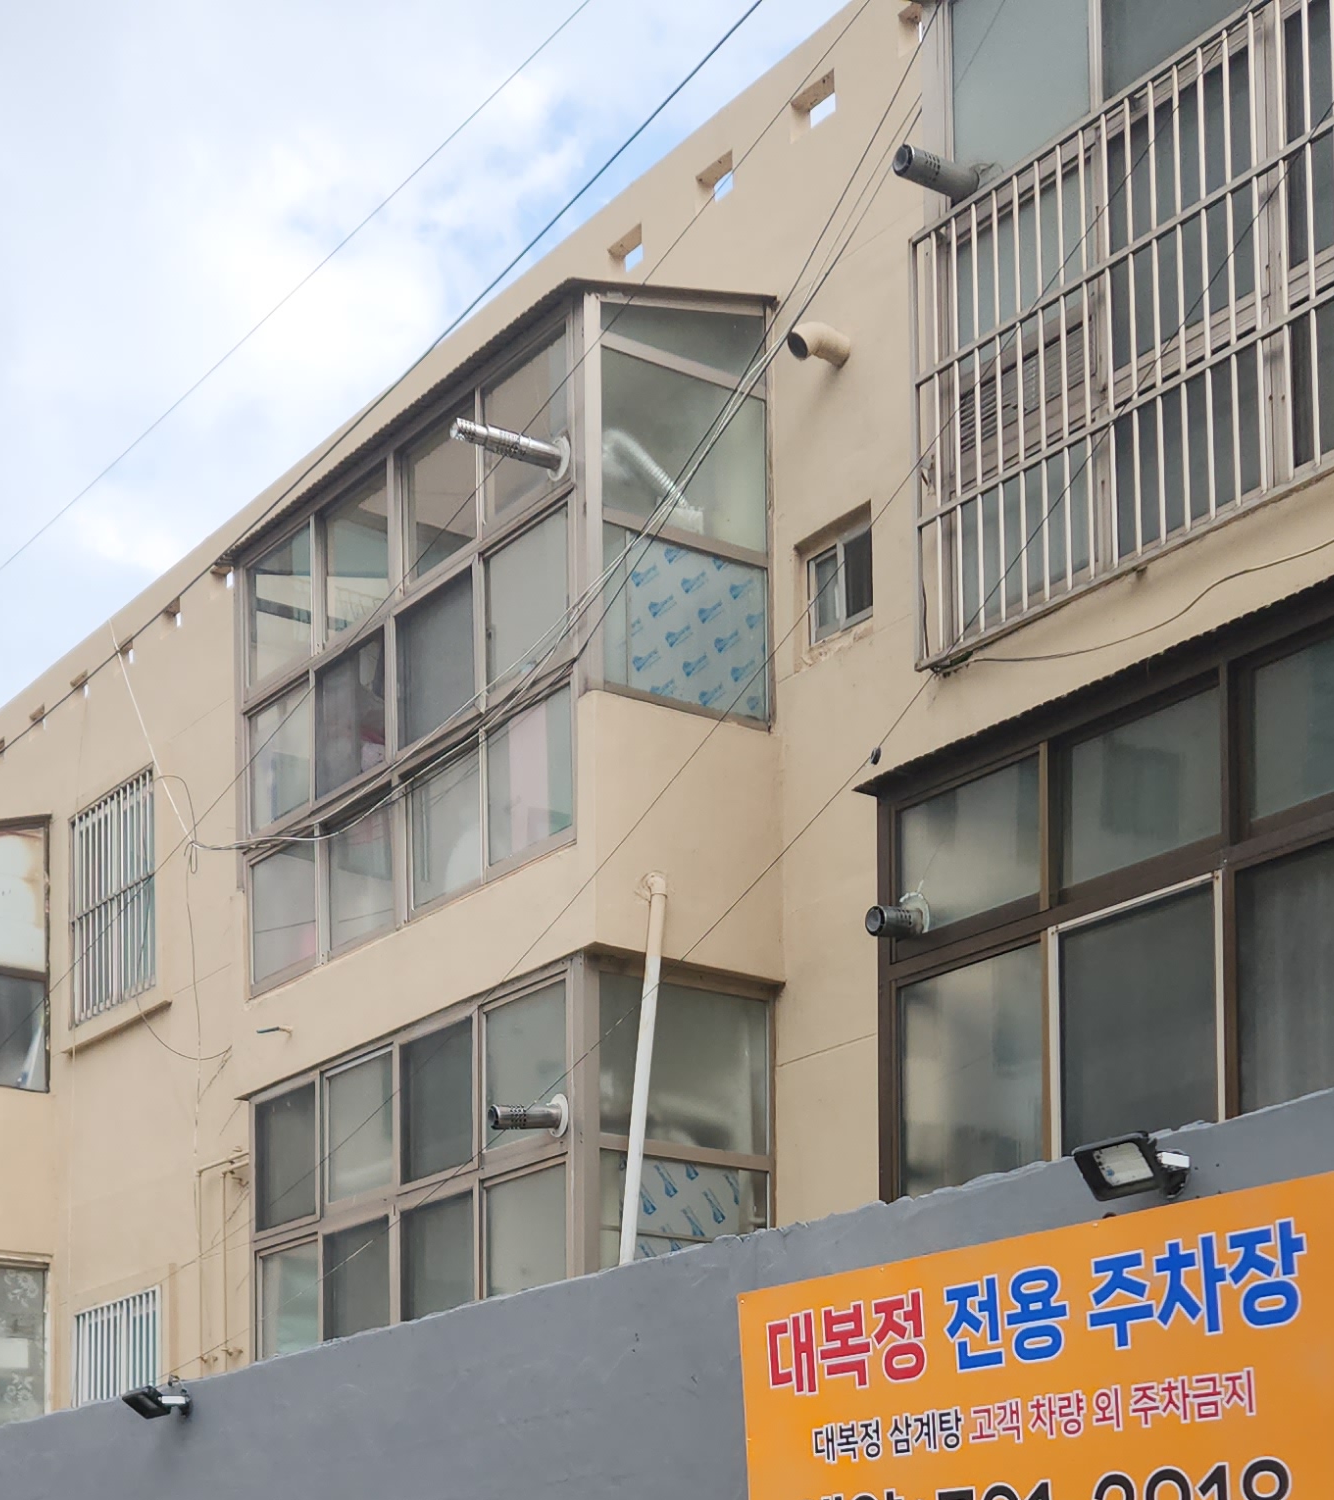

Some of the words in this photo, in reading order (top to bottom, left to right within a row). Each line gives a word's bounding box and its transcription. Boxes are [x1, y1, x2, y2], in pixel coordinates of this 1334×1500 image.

[766, 1288, 926, 1396] 대복정
[944, 1265, 1068, 1373] 전용
[1087, 1217, 1307, 1350] 주차장
[812, 1419, 881, 1464] 대복정
[888, 1407, 964, 1456] 삼계탕
[969, 1399, 1023, 1444] 고객
[1028, 1390, 1085, 1439] 차량
[1092, 1385, 1124, 1432] 외
[1129, 1367, 1257, 1428] 주차금지
